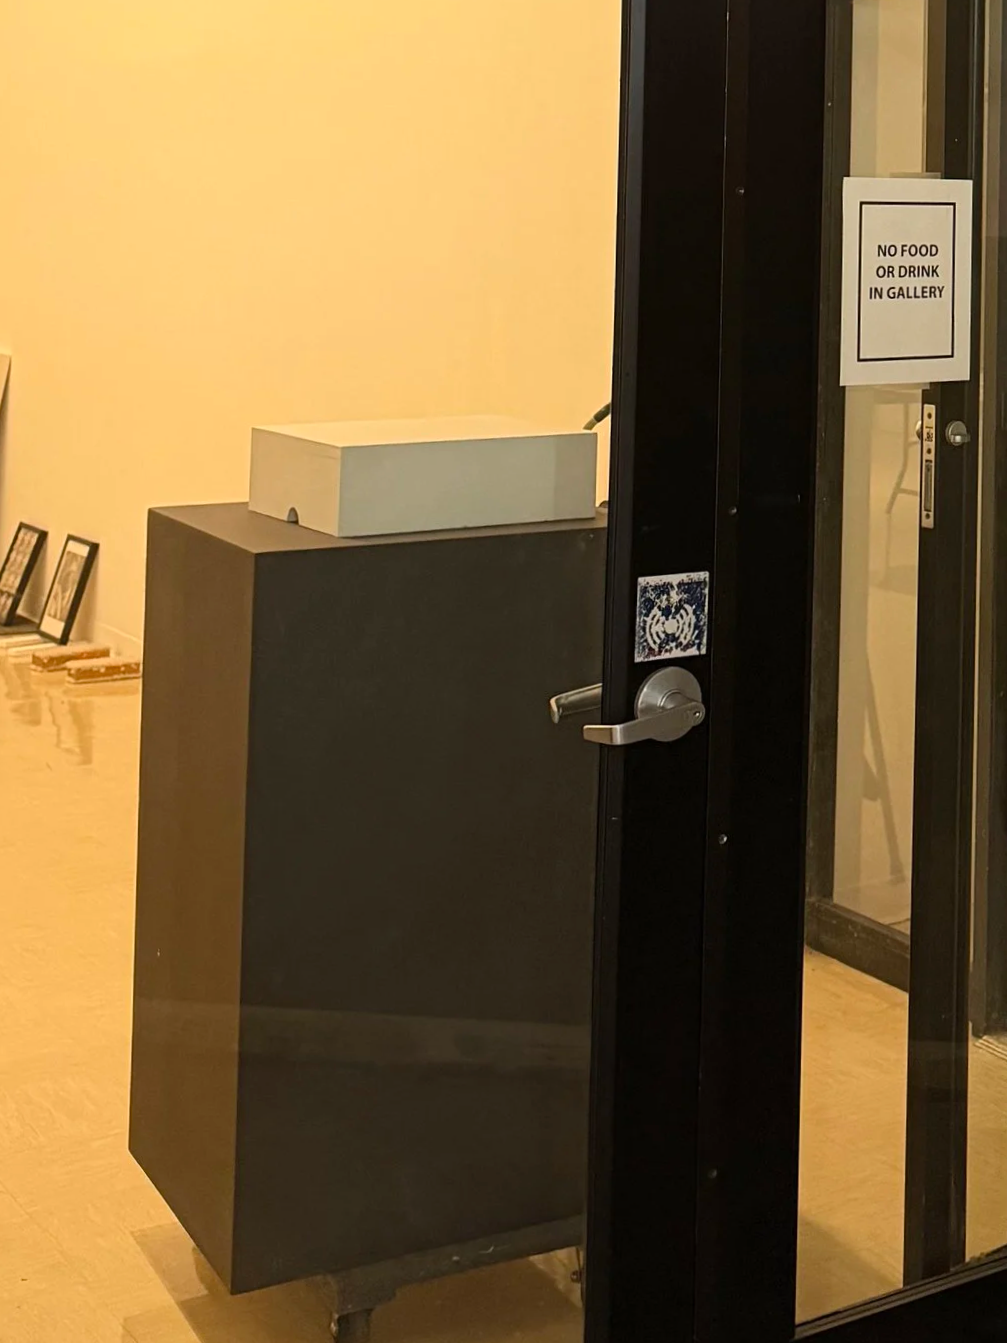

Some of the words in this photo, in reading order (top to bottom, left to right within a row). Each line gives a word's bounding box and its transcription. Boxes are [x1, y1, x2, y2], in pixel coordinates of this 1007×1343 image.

[877, 244, 898, 258] NO
[900, 243, 939, 258] FOOD
[875, 265, 895, 279] OR
[898, 264, 940, 278] DRINK
[869, 286, 884, 300] IN
[886, 285, 946, 300] GALLERY
